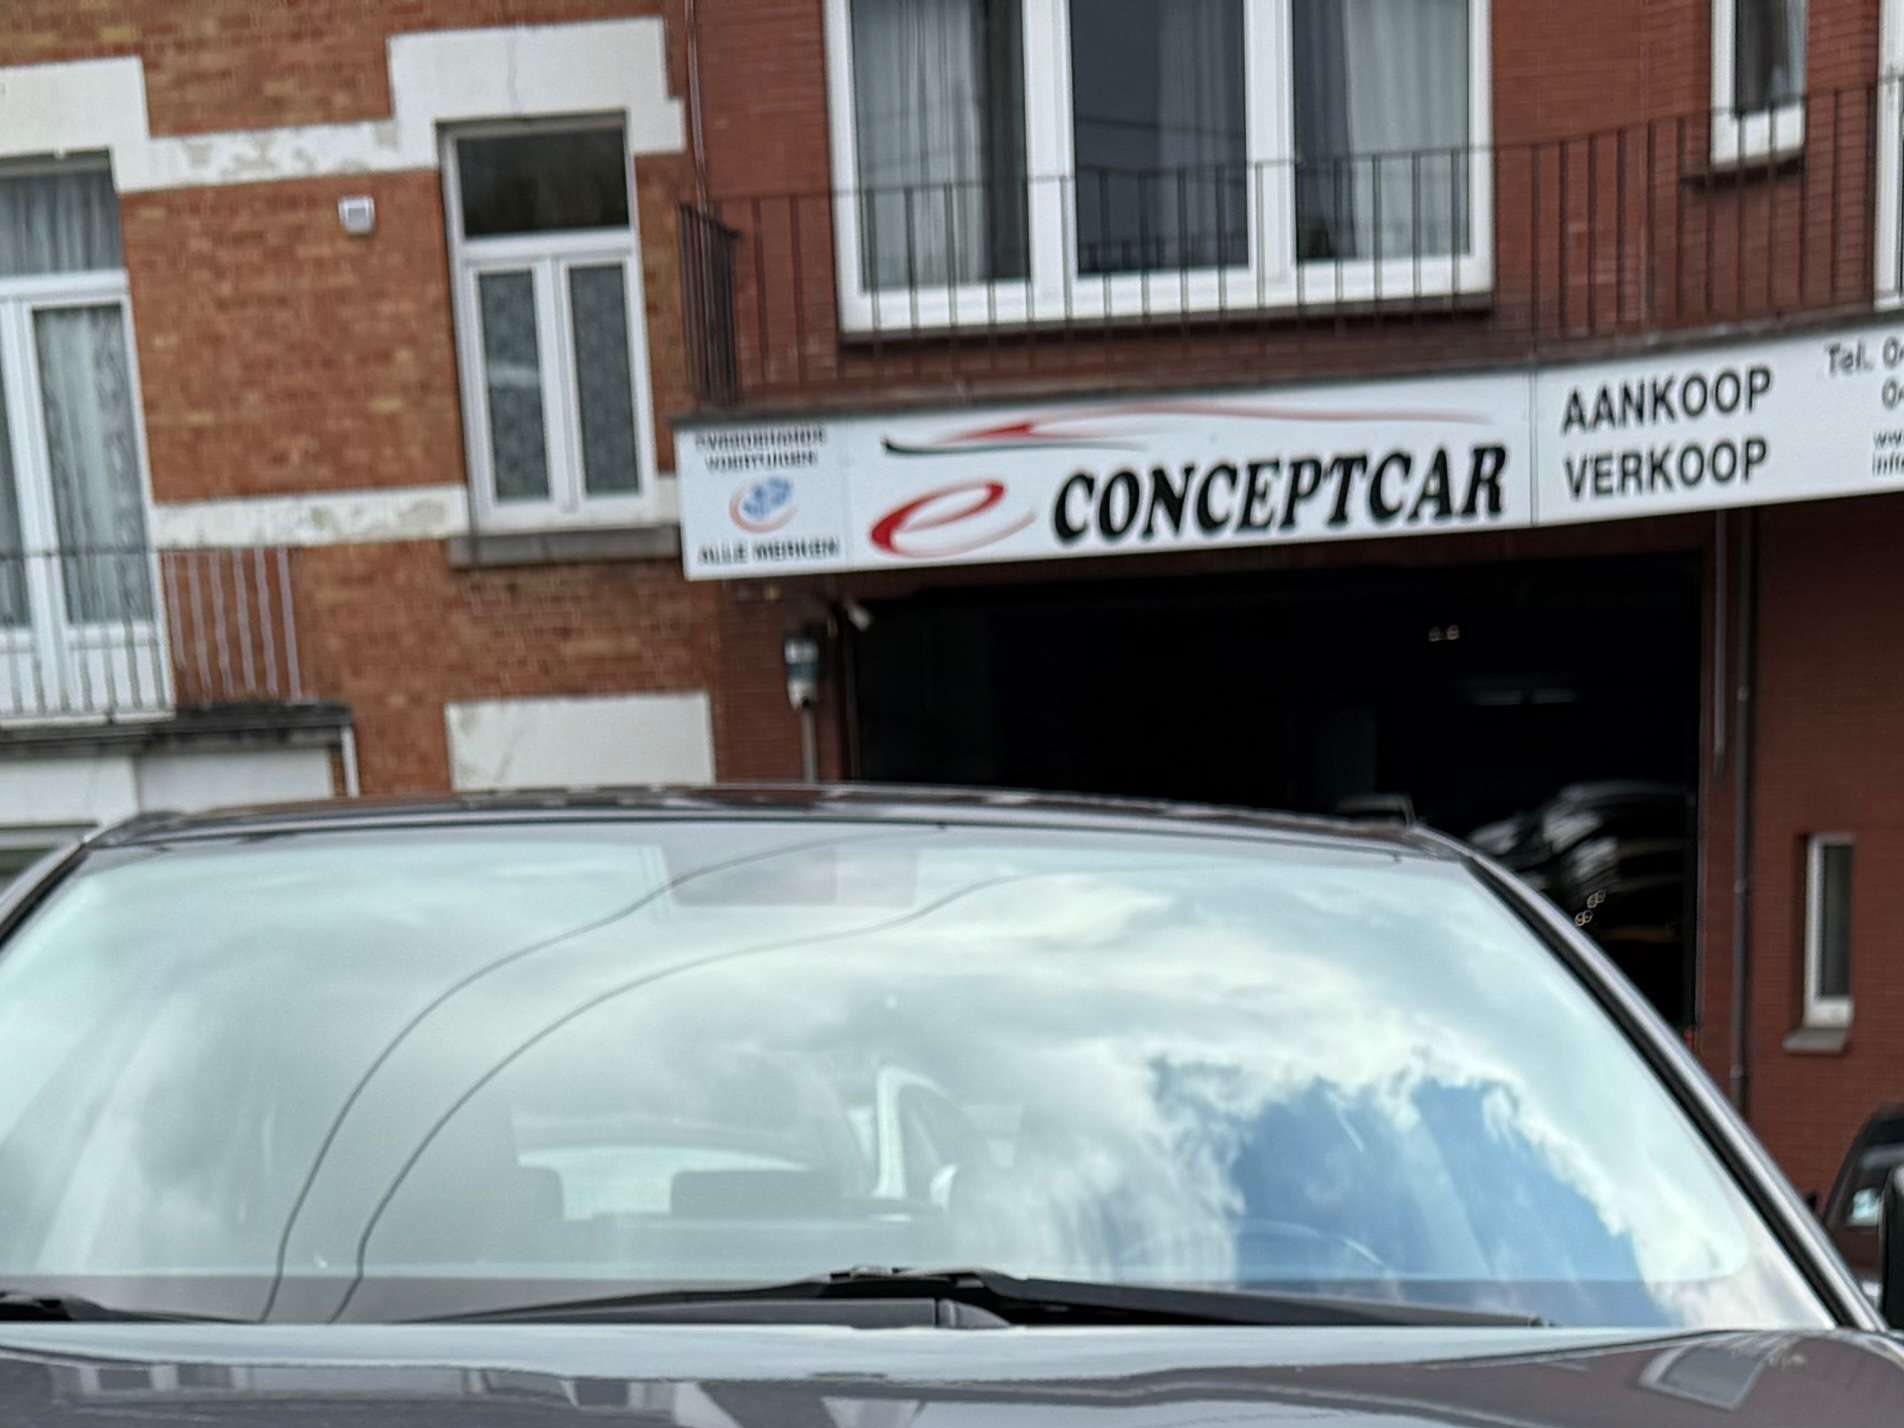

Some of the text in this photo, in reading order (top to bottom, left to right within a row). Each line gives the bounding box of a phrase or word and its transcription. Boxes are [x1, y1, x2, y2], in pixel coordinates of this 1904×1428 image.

[1825, 338, 1874, 375] Tel.
[1561, 366, 1772, 434] AANKOOP
[1053, 444, 1507, 545] CONCEPTCAR
[1565, 436, 1768, 500] VERKOOP
[698, 541, 747, 564] ALLE
